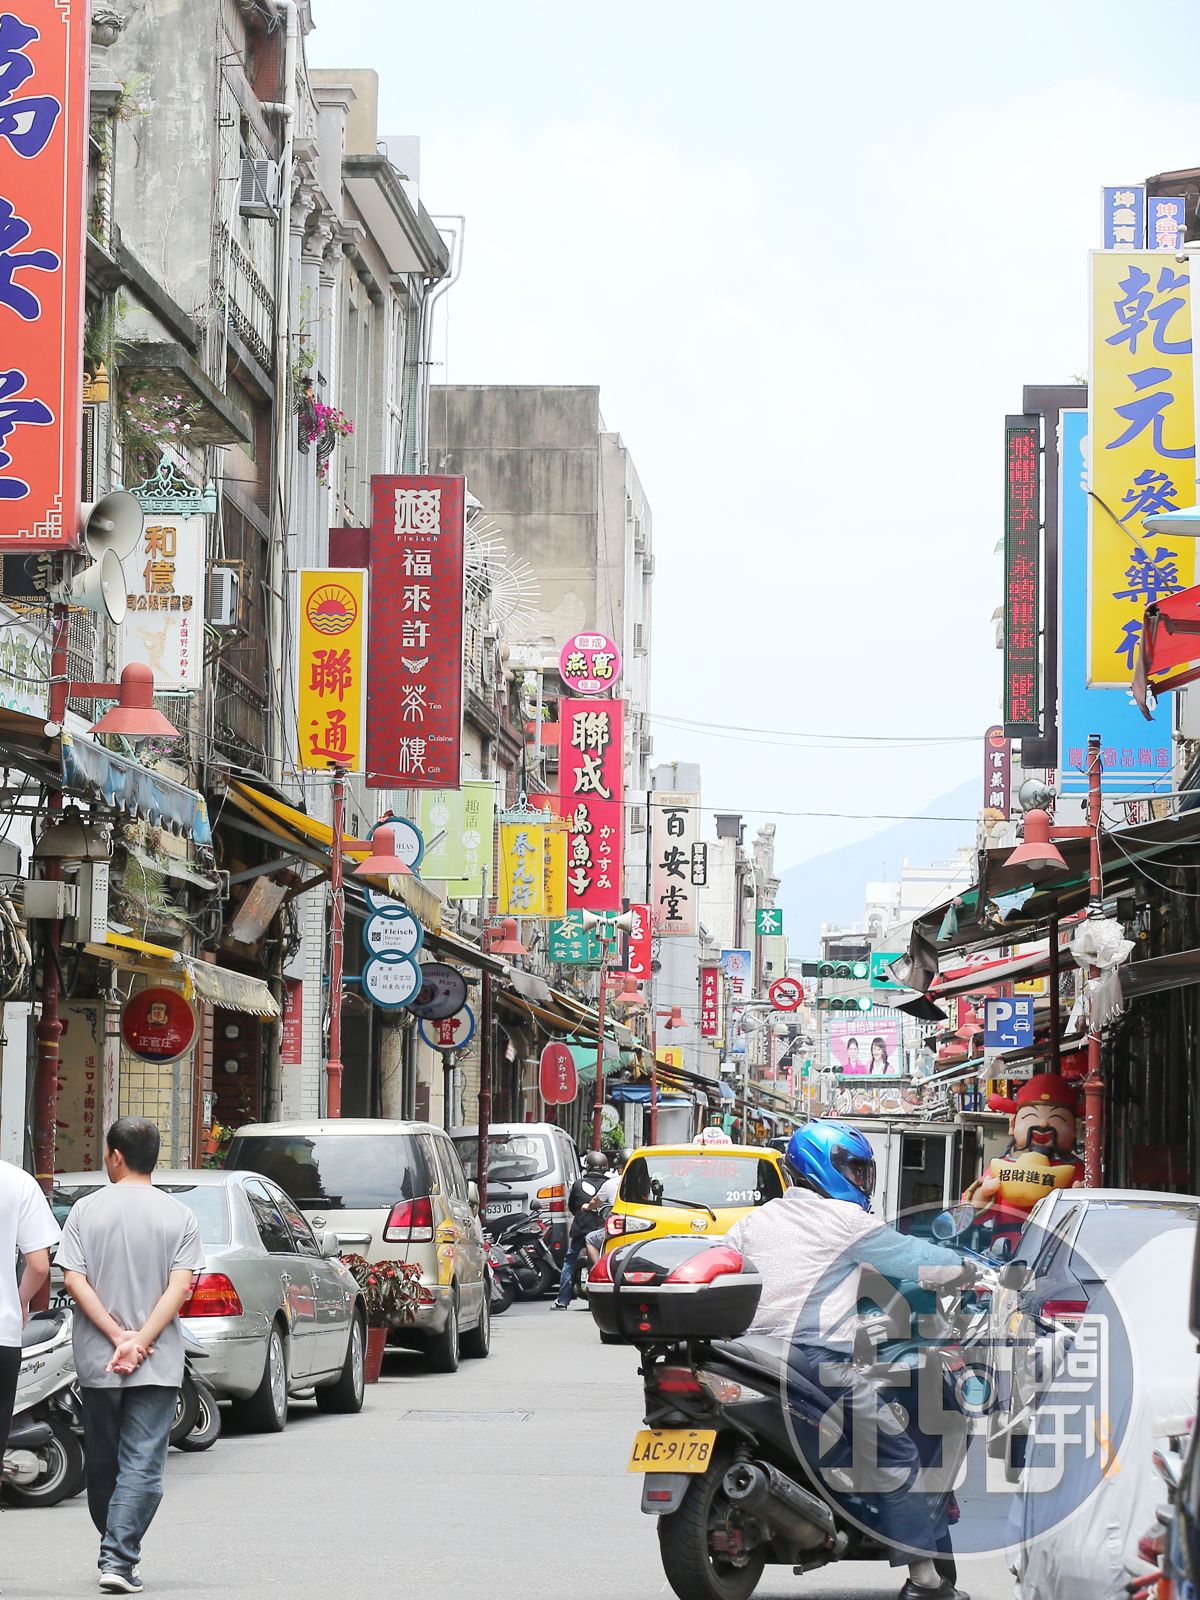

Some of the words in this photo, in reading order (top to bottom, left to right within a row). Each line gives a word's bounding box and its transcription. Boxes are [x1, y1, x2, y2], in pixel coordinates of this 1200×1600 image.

[1112, 190, 1136, 249] 坤益有
[1155, 202, 1177, 249] 坤益有
[143, 525, 177, 593] 和億
[401, 548, 432, 648] 福來許
[565, 651, 616, 679] 燕窩
[308, 648, 354, 761] 聯通
[399, 684, 427, 775] 茶樓
[597, 824, 617, 890] からすみ
[659, 808, 690, 921] 百安堂
[554, 914, 582, 940] 茶
[758, 910, 780, 934] 茶
[987, 1001, 1013, 1031] P
[557, 1055, 568, 1091] からすみ
[726, 1190, 761, 1201] 20179
